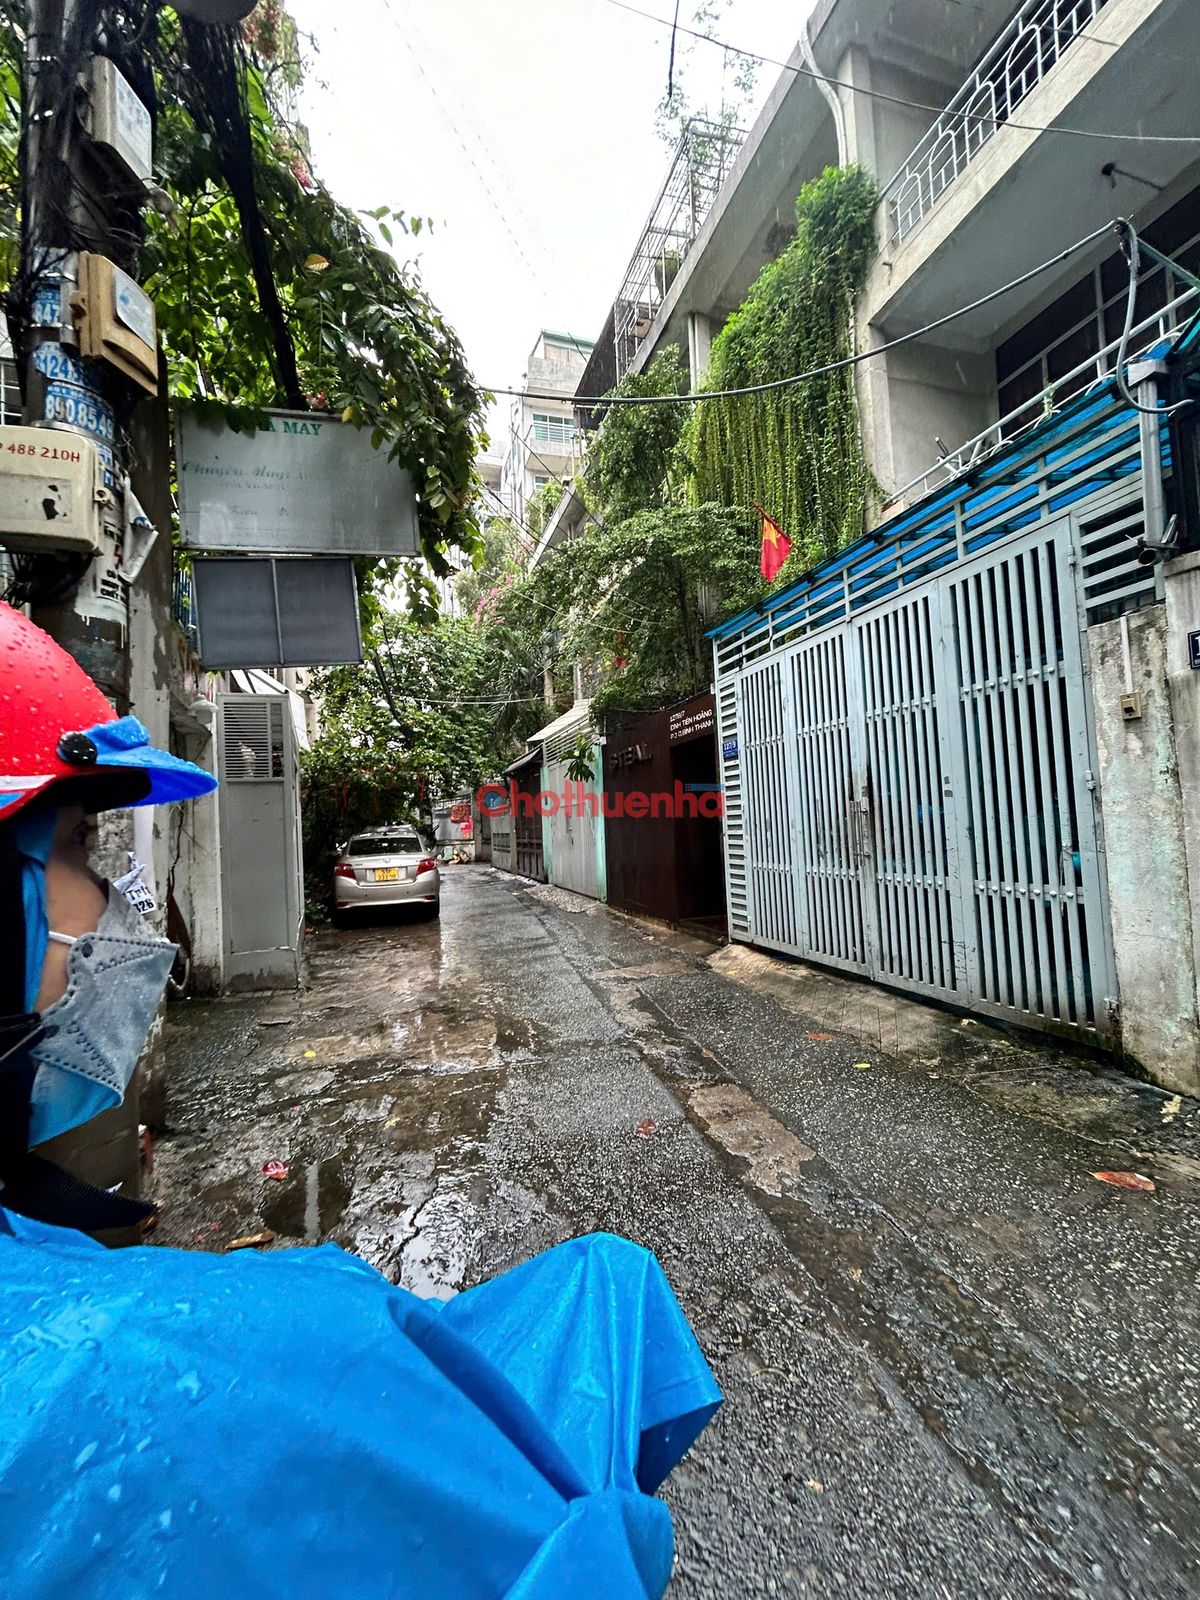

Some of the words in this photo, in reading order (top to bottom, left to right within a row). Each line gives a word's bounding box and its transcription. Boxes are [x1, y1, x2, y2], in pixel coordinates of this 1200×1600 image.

[283, 421, 322, 436] MAY
[7, 443, 36, 456] 488
[40, 446, 80, 463] 210H
